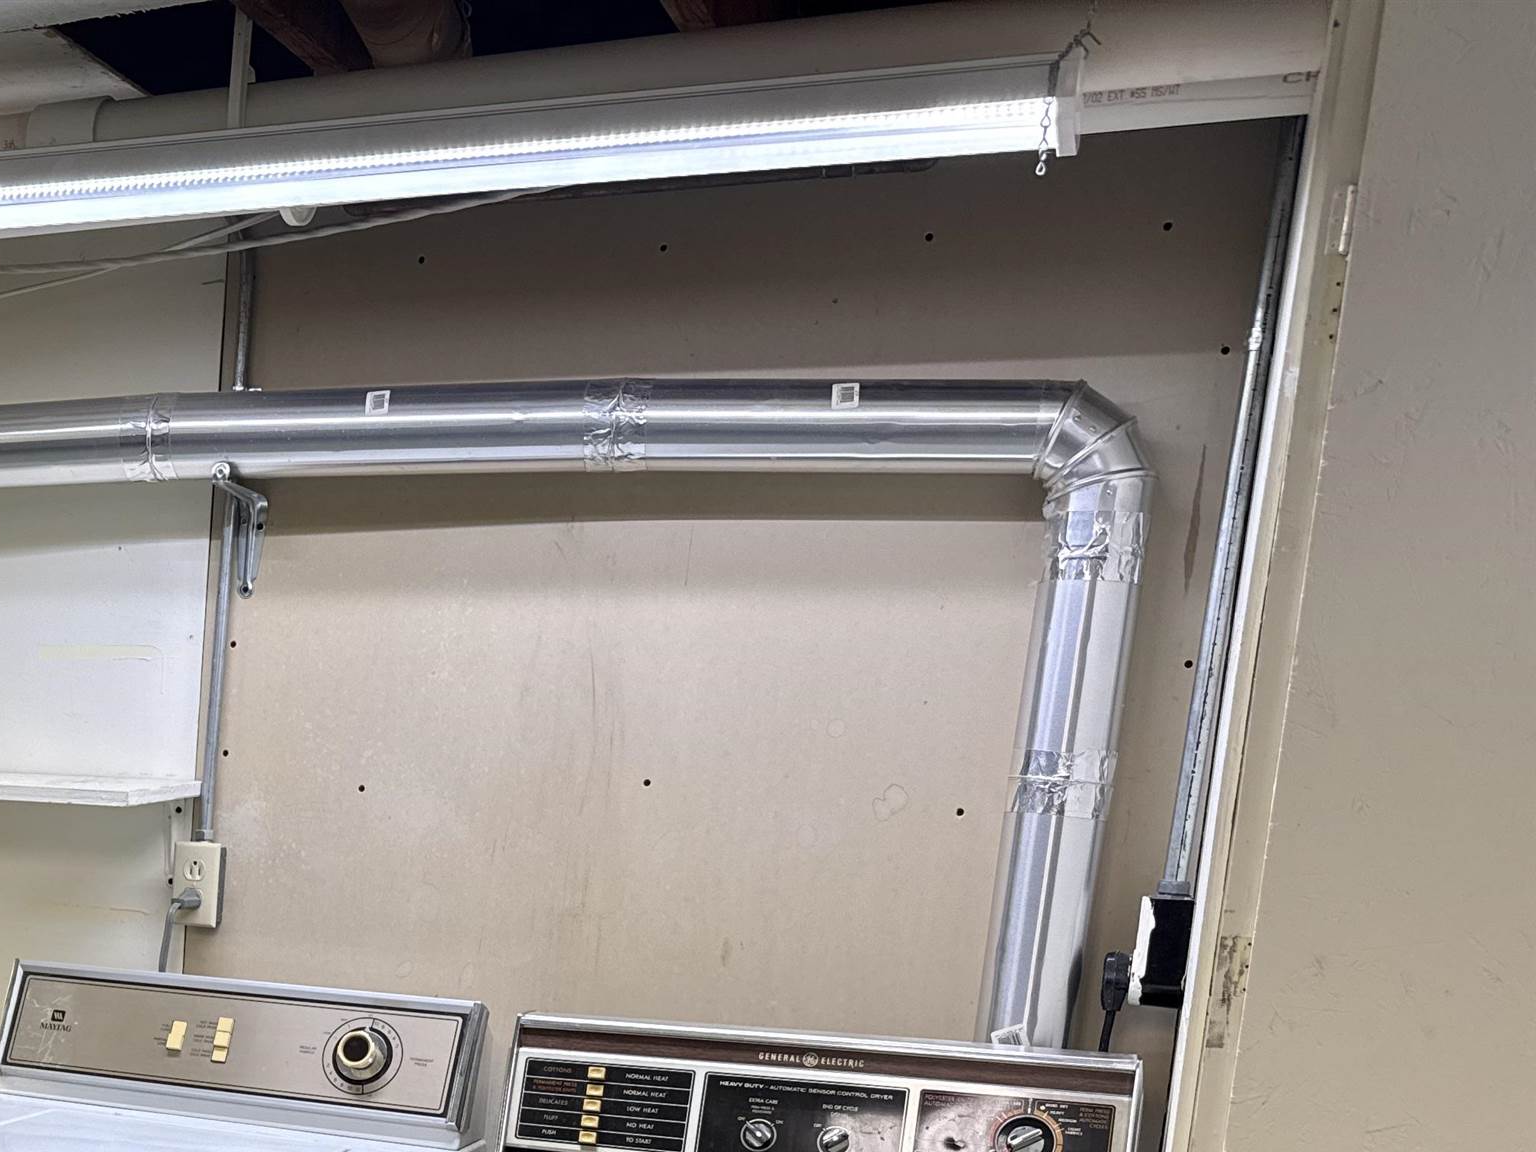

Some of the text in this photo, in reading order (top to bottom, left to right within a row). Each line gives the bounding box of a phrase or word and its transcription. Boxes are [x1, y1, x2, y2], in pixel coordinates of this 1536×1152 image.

[39, 1022, 72, 1033] MAYTAG
[758, 1052, 801, 1063] GENERAL
[820, 1056, 865, 1068] ELECTRIC
[625, 1073, 651, 1081] NORMAL
[623, 1089, 648, 1097] NORMAL
[769, 1085, 807, 1093] AUTOMATIC
[837, 1090, 868, 1098] CONTROL
[538, 1098, 569, 1106] DELICATES
[541, 1128, 556, 1136] PUSH
[635, 1137, 652, 1145] START
